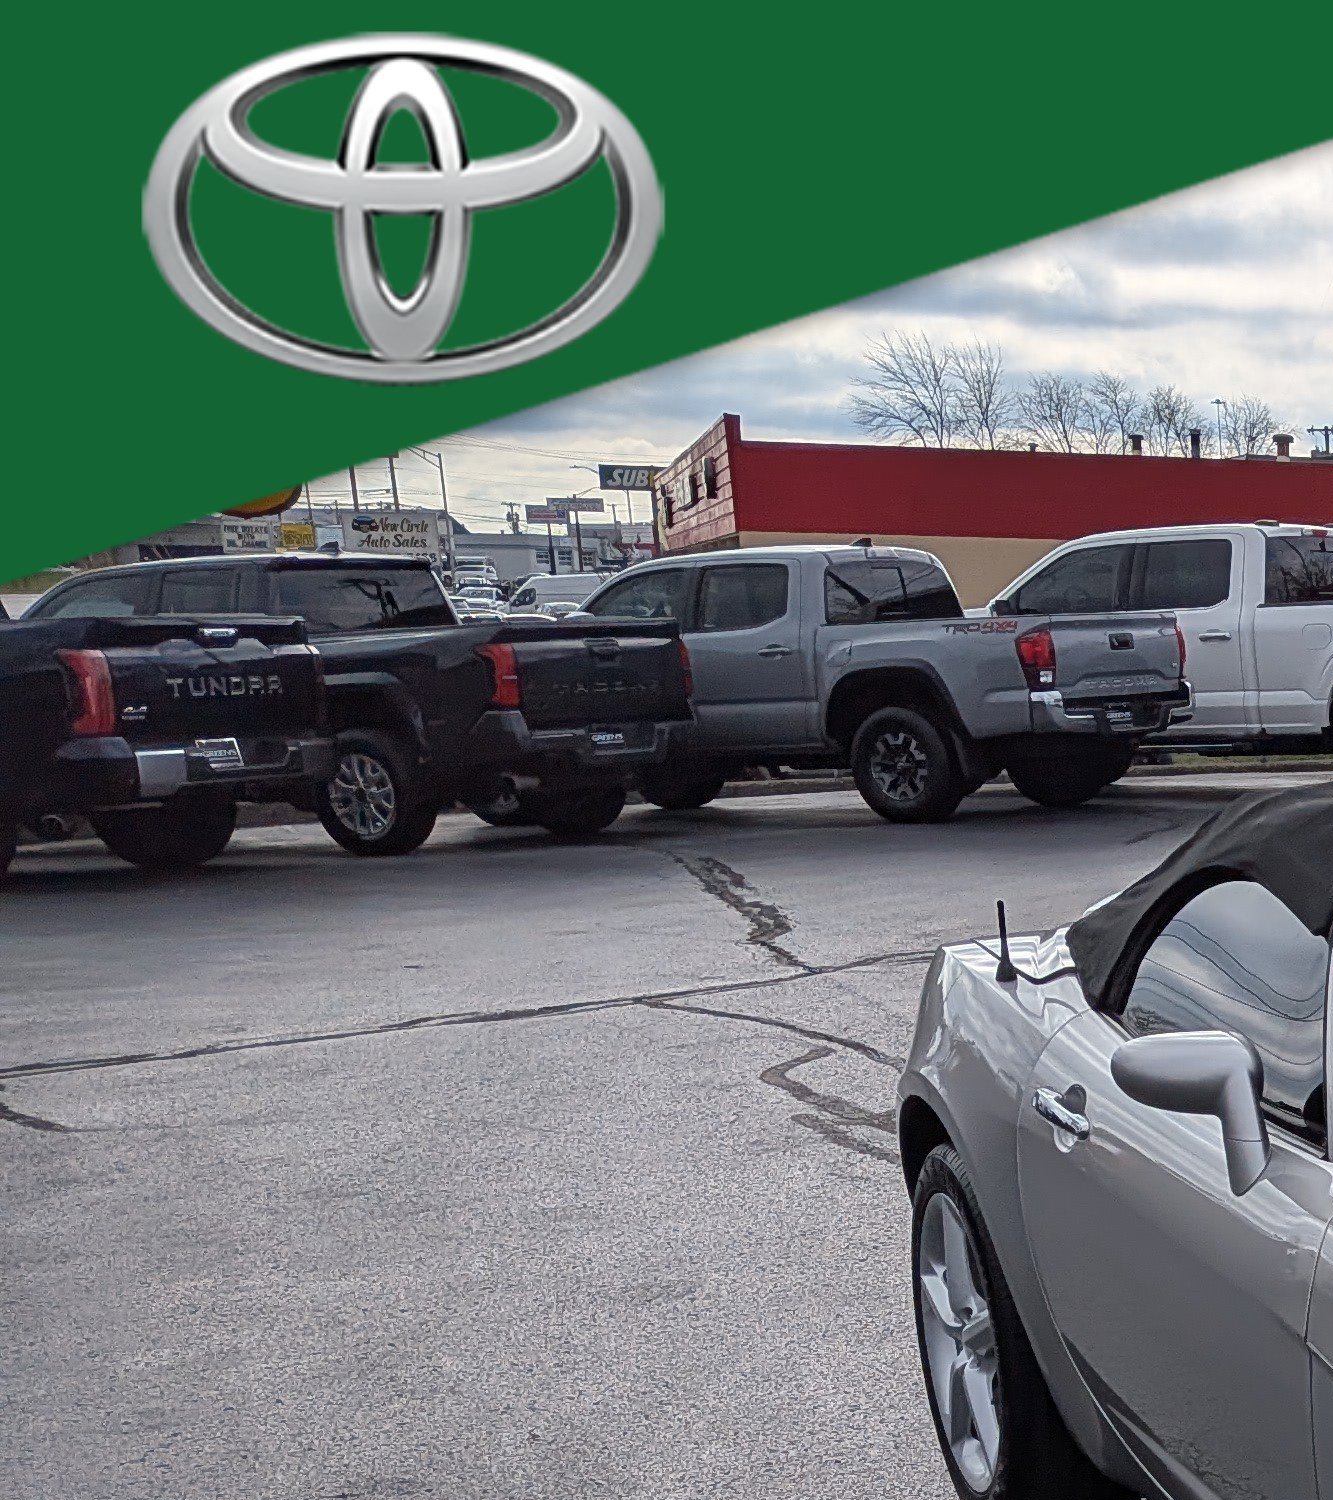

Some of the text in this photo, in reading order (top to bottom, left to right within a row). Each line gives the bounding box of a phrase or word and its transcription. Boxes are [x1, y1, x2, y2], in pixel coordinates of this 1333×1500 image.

[607, 468, 655, 488] SUB
[379, 516, 429, 534] New Circle
[358, 533, 429, 549] Auto Sales
[166, 674, 283, 699] TUNDRA
